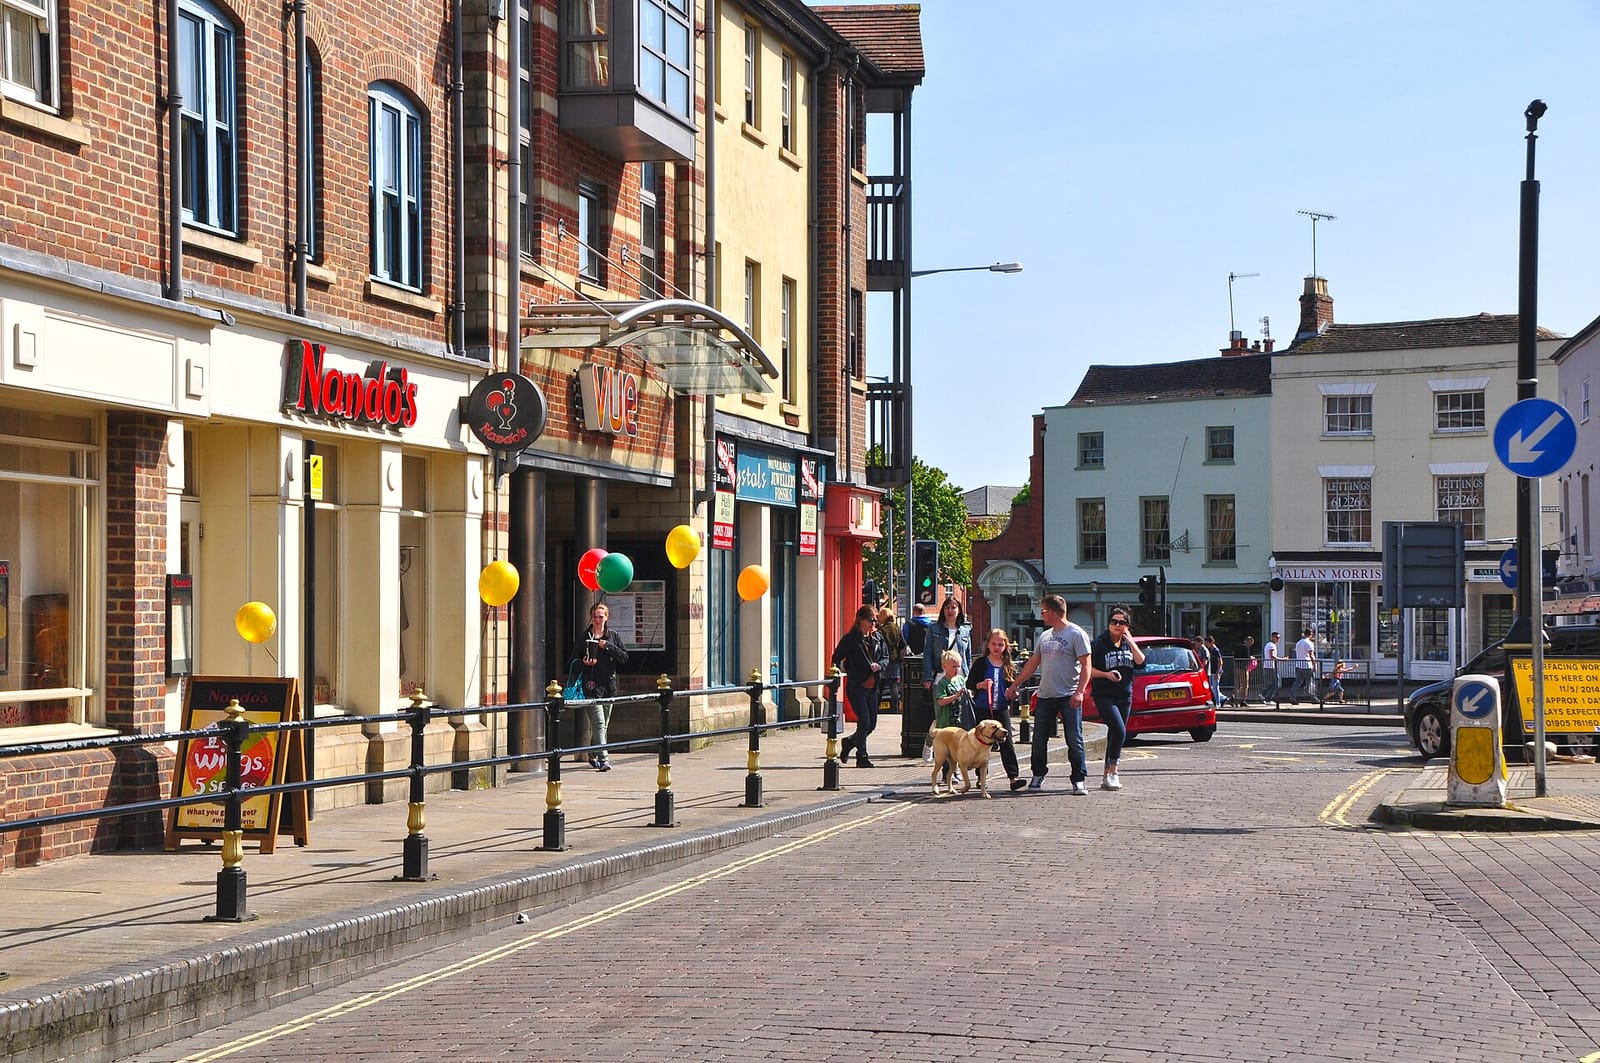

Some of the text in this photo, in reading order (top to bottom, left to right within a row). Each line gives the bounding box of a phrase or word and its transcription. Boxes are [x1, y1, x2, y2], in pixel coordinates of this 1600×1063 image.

[296, 339, 418, 428] Nando's
[479, 422, 527, 444] Nando's
[1327, 480, 1371, 492] LETTINGS
[1438, 478, 1483, 490] LETTINGS
[1331, 496, 1367, 508] 612266
[1442, 495, 1479, 507] 612266
[1284, 568, 1382, 579] ALLAN MORRIS
[1561, 674, 1584, 682] HERE
[1585, 674, 1599, 682] ON
[1546, 696, 1579, 704] APPROX
[1546, 719, 1599, 727] 01905 761160
[194, 748, 266, 777] wigs,
[194, 777, 207, 796] 5
[187, 805, 206, 815] What
[206, 806, 219, 817] you
